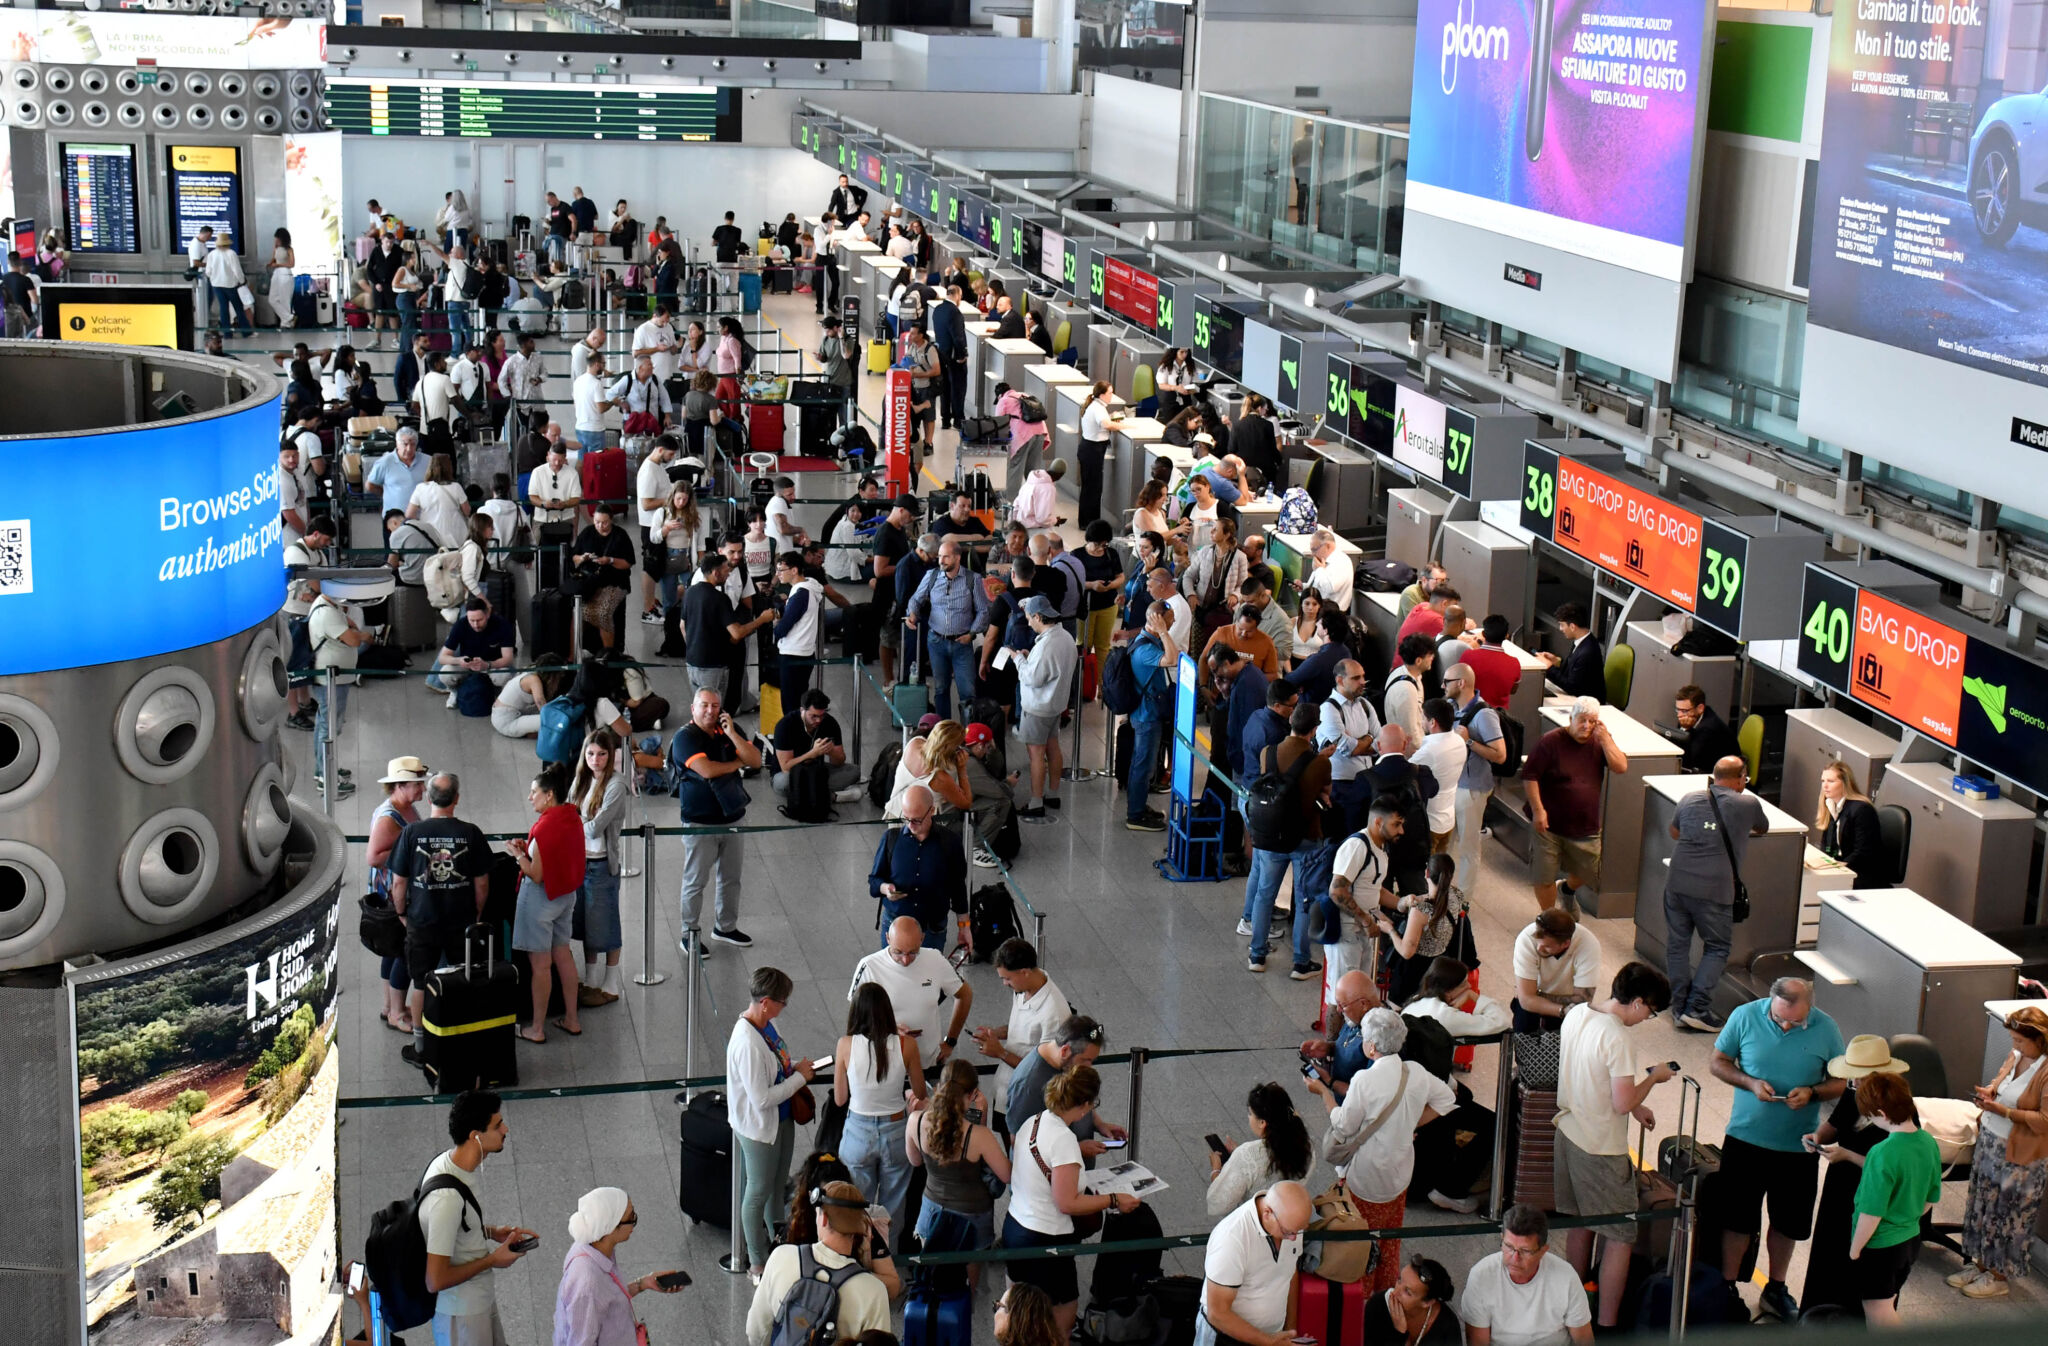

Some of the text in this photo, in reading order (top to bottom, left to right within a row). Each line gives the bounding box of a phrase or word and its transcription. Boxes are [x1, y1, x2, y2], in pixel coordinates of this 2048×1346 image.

[1581, 13, 1673, 31] SEI UN CONSUMATORE ADULTO?
[1858, 0, 1981, 26] Cambia il tuo look.
[1572, 32, 1678, 62] ASSAPORA NUOVE
[1855, 30, 1952, 62] Non il tuo stile.
[1561, 56, 1687, 92] SFUMATURE DI GUSTO
[1867, 72, 1882, 83] YOUR
[1590, 89, 1612, 105] VISITA
[1851, 82, 1859, 92] LA
[1900, 87, 1916, 99] 100%
[838, 144, 846, 165] 24
[881, 164, 887, 187] 26
[895, 172, 903, 195] 27
[930, 189, 939, 213] 28
[949, 197, 958, 222] 29
[991, 216, 1001, 245] 30
[1012, 227, 1022, 256] 31
[1064, 251, 1076, 283] 32
[1090, 263, 1104, 296] 33
[91, 316, 132, 325] Volcanic
[1158, 294, 1173, 331] 34
[91, 326, 126, 335] activity
[1194, 311, 1210, 349] 35
[1938, 337, 1954, 350] Macan
[1968, 346, 1991, 360] Consumo
[1991, 351, 2012, 365] elettrico
[1328, 373, 1349, 417] 36
[894, 396, 907, 456] ECONOMY
[1394, 407, 1444, 461] Aeroitalia
[1446, 427, 1472, 475] 37
[1524, 465, 1554, 518] 38
[160, 487, 251, 531] Browse
[1560, 469, 1698, 548] BAG DROP BAG DROP
[159, 523, 259, 582] authentic
[1702, 547, 1741, 608] 39
[1804, 600, 1849, 663] 40
[1860, 606, 1960, 670] BAG DROP
[1922, 715, 1953, 737] easyJet
[2009, 706, 2045, 730] aeroporto
[282, 928, 316, 965] HOME
[280, 955, 305, 983] SUD
[280, 963, 314, 1001] HOME
[252, 999, 299, 1034] Living Sicily
